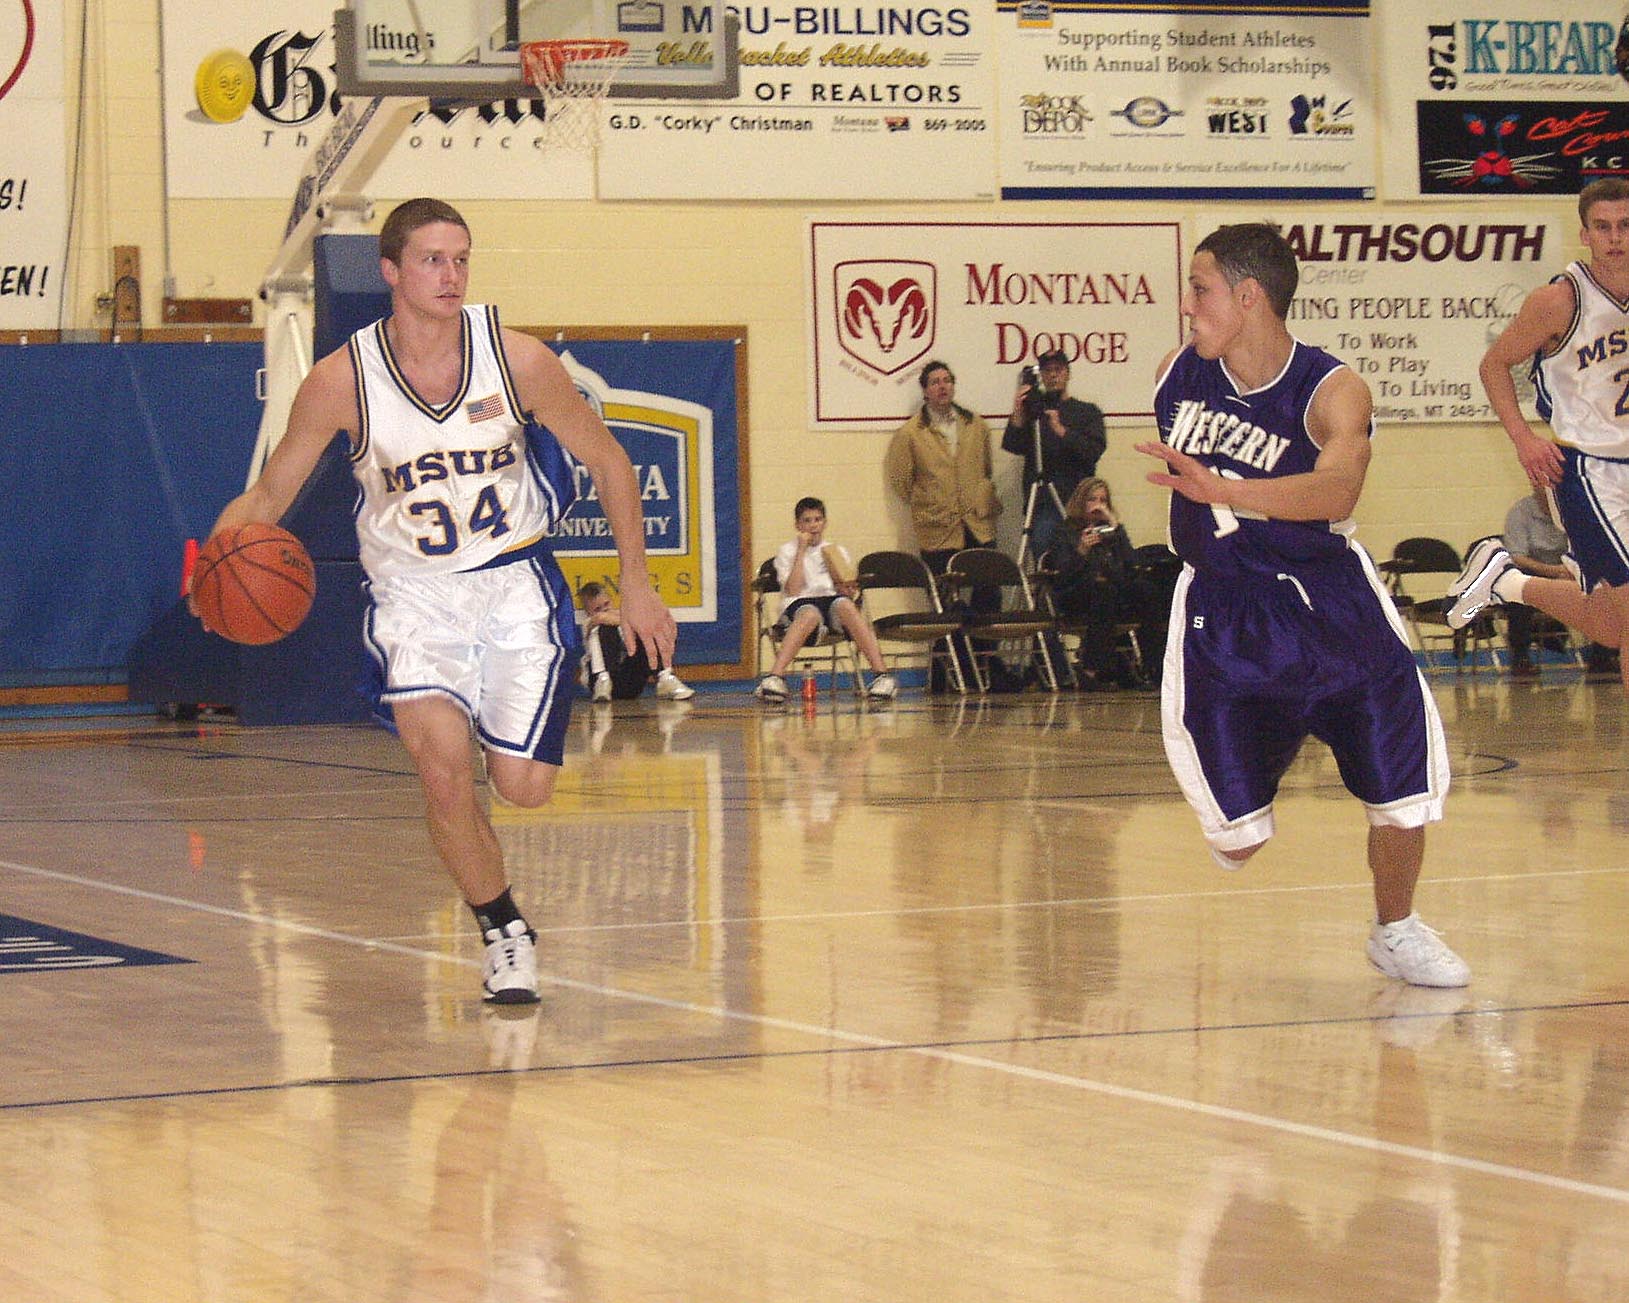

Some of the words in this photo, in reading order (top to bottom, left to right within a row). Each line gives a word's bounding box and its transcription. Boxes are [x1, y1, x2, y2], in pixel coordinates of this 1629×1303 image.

[1057, 28, 1161, 50] Supporting
[1166, 29, 1236, 47] Student
[1242, 29, 1316, 48] Athletes
[1462, 19, 1618, 76] K-BEAR
[818, 42, 931, 67] Athletics
[1427, 22, 1457, 91] 97.1
[1044, 54, 1088, 72] With
[1093, 55, 1160, 73] Annual
[1167, 56, 1212, 73] Book
[1217, 56, 1331, 79] Scholarships
[755, 83, 792, 101] OF
[811, 84, 962, 103] REALTORS
[610, 116, 646, 130] G.D.
[654, 115, 722, 133] "Corky"
[730, 116, 813, 131] Christman
[264, 130, 308, 147] Th
[410, 136, 543, 149] ource
[1278, 223, 1546, 262] ALTHSOUTH
[964, 263, 1156, 305] MONTANA
[1301, 265, 1368, 284] Center
[1290, 298, 1339, 320] TING
[1349, 298, 1431, 319] PEOPLE
[1441, 298, 1518, 320] BACK...
[995, 322, 1130, 366] DODGE
[1338, 333, 1361, 349] To
[1370, 332, 1419, 349] Work
[1357, 357, 1380, 373] To
[1388, 356, 1430, 377] Play
[1379, 381, 1402, 397] To
[1411, 380, 1472, 400] Living
[381, 443, 517, 494] MSUB
[408, 484, 511, 556] 34
